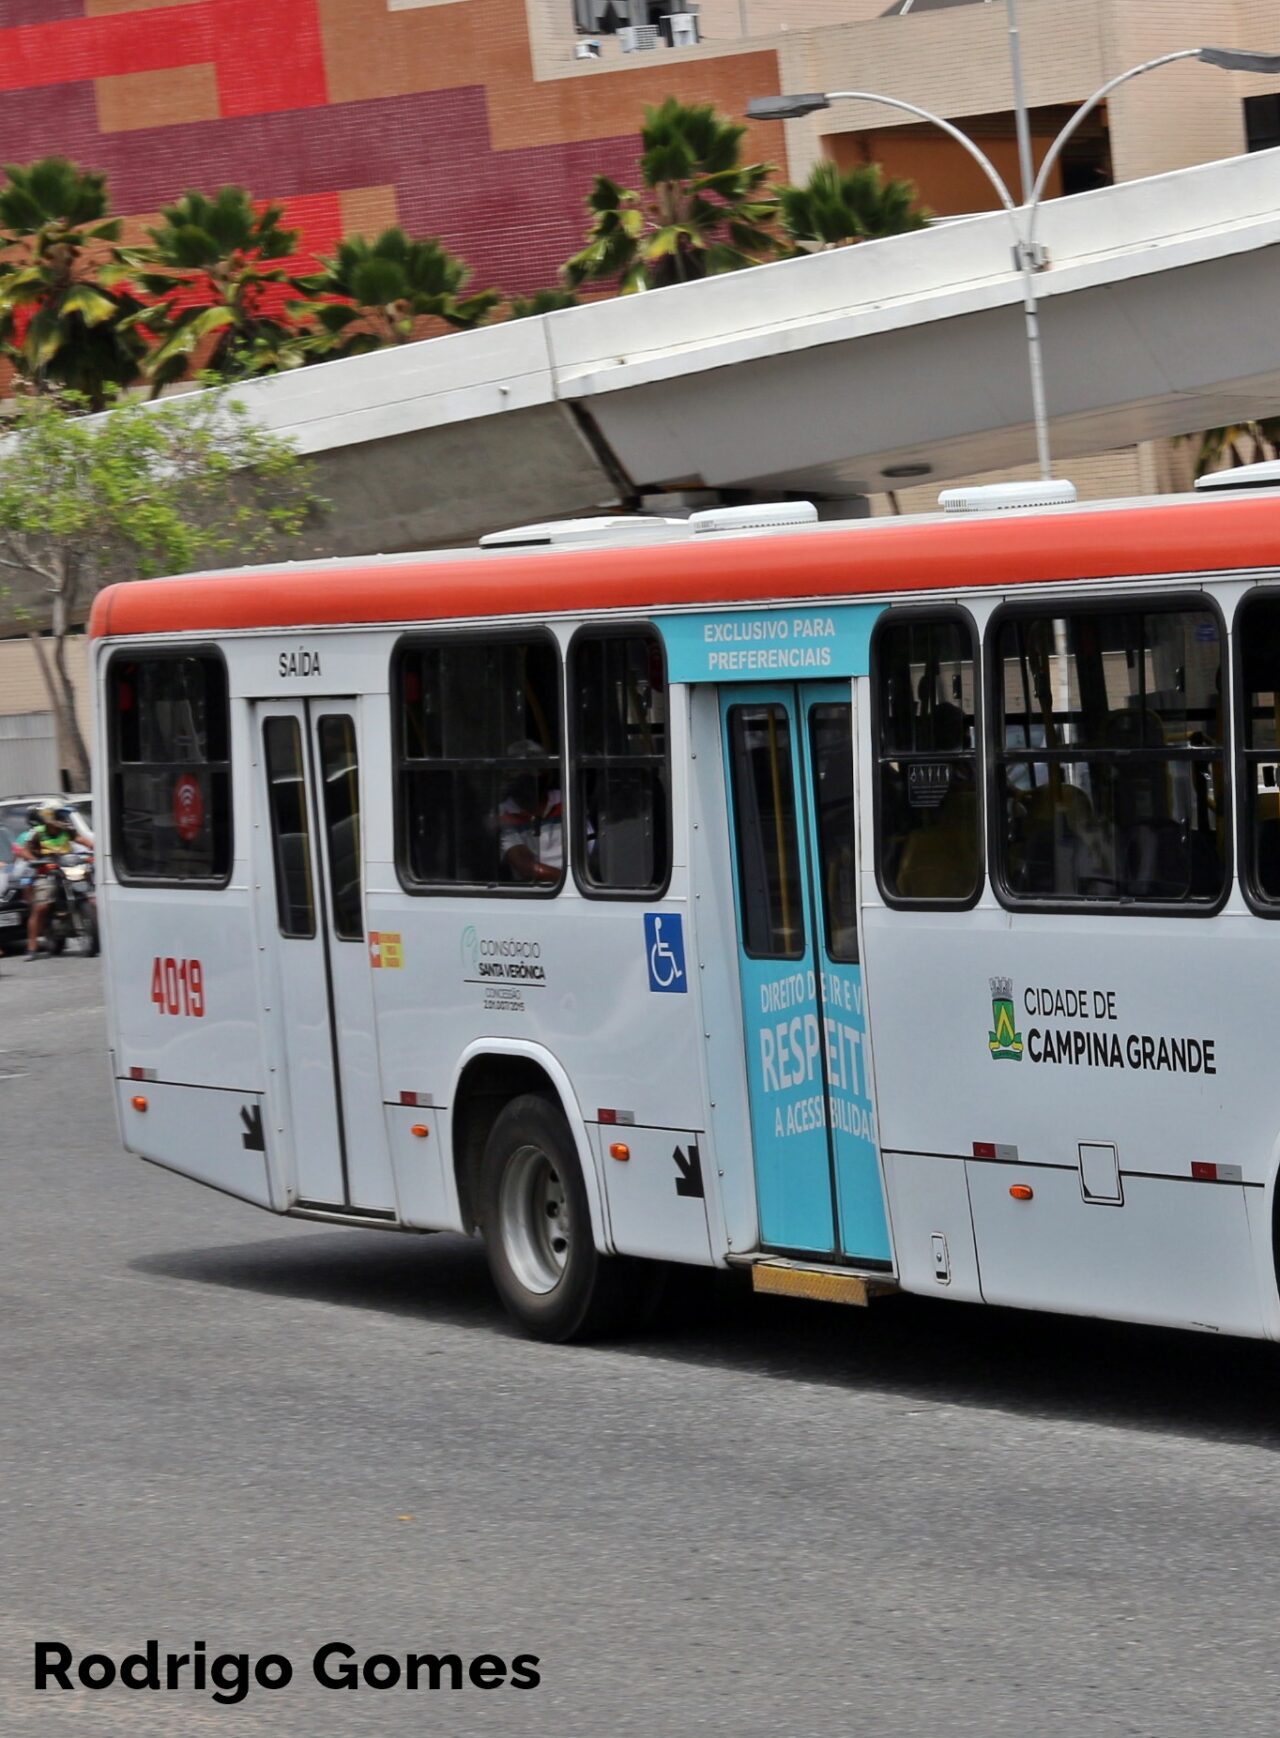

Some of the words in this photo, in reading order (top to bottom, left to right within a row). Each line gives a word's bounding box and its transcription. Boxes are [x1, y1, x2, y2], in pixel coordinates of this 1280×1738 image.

[703, 620, 789, 642] EXCLUSIVO
[793, 618, 836, 638] PARA
[278, 645, 322, 678] SAÍDA
[708, 647, 832, 671] PREFERENCIAIS
[480, 937, 541, 959] CONSÓRCIO
[478, 963, 504, 977] SANTA
[504, 960, 547, 980] VERÔNICA
[150, 956, 206, 1018] 4019
[759, 973, 805, 1014] DIREITO
[807, 969, 827, 1003] DE
[829, 973, 843, 1008] IR
[843, 979, 852, 1011] E
[1023, 987, 1089, 1018] CIDADE
[1093, 990, 1118, 1020] DE
[1027, 1028, 1125, 1068] CAMPINA
[1126, 1034, 1217, 1075] GRANDE
[775, 1106, 785, 1138] A
